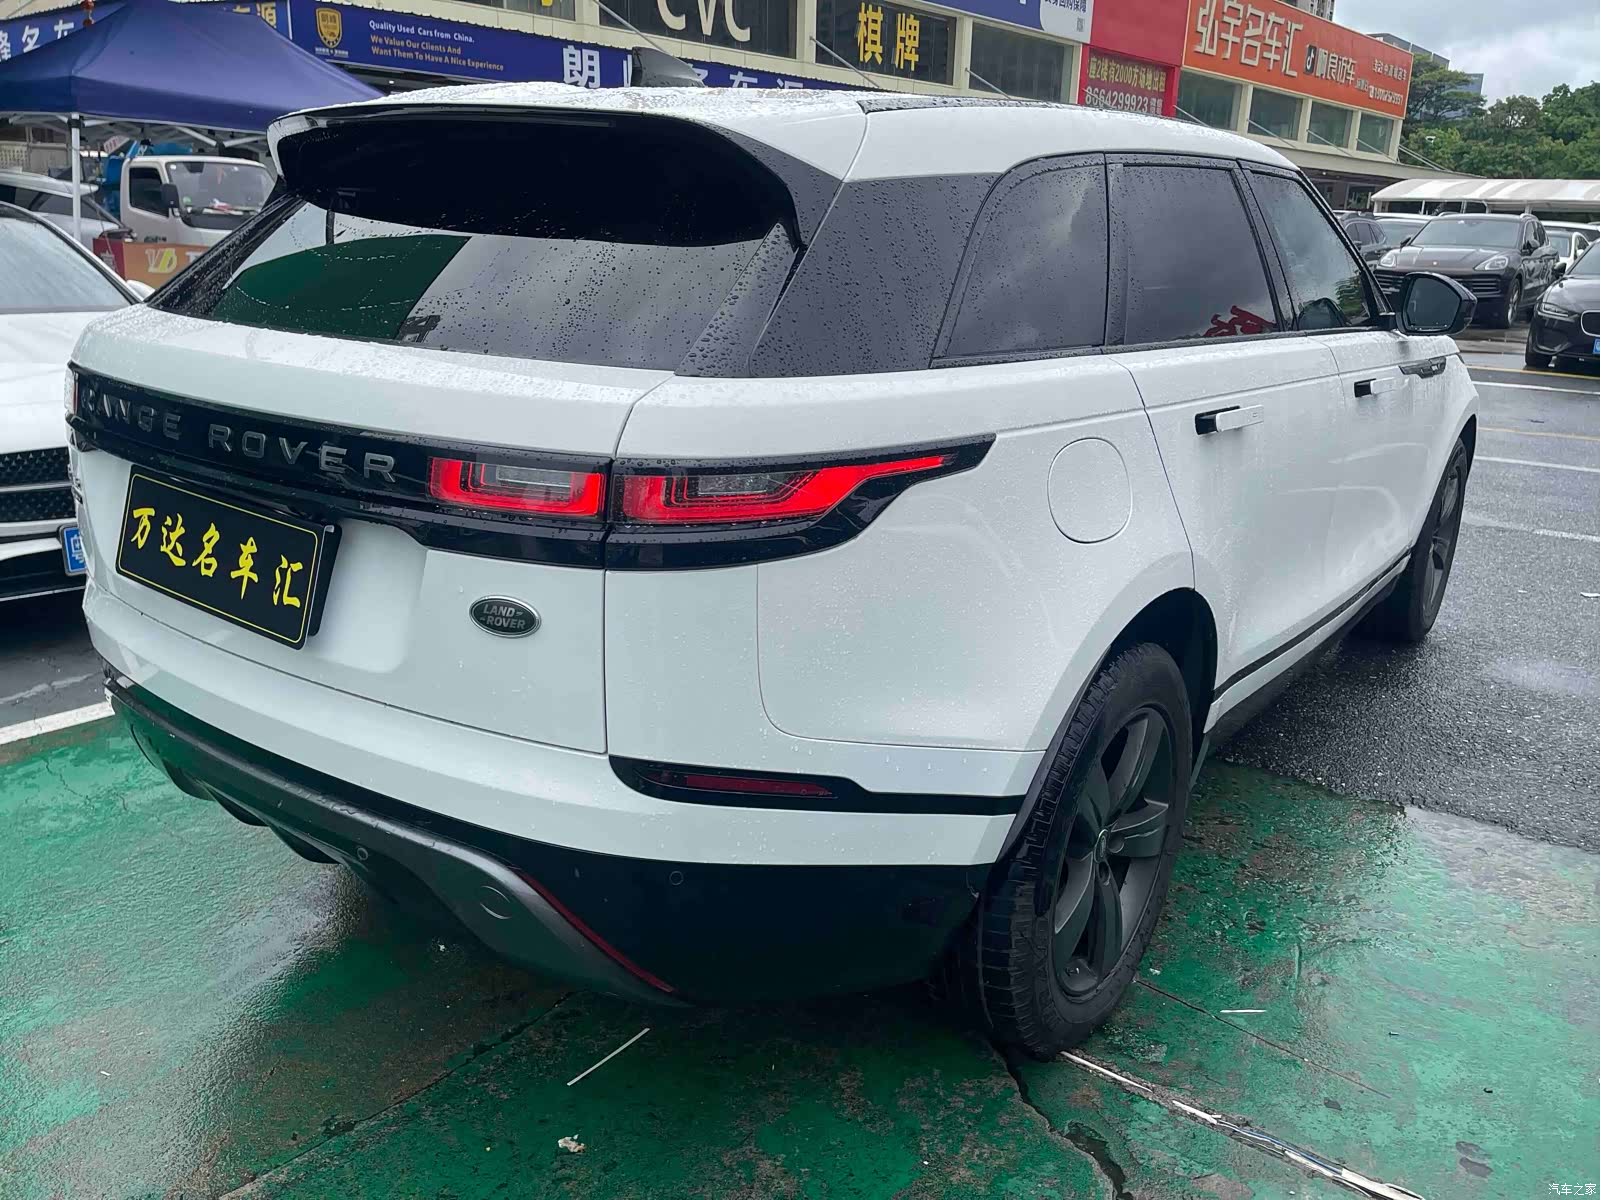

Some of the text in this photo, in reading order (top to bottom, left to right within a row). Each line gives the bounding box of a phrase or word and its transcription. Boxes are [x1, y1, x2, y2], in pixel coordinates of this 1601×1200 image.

[369, 20, 475, 44] Quality Used Cars from China.
[370, 34, 461, 55] We Value Our Clients And
[855, 2, 920, 71] 棋牌
[1194, 0, 1304, 77] 弘宇名车汇
[371, 46, 504, 72] Want Them To Have A Nice Experience
[1087, 57, 1167, 92] 座2楼有2000方场地出租
[208, 423, 396, 483] ROVER
[131, 507, 303, 608] 万达名车汇
[483, 604, 516, 617] LAND
[486, 615, 526, 629] ROVER
